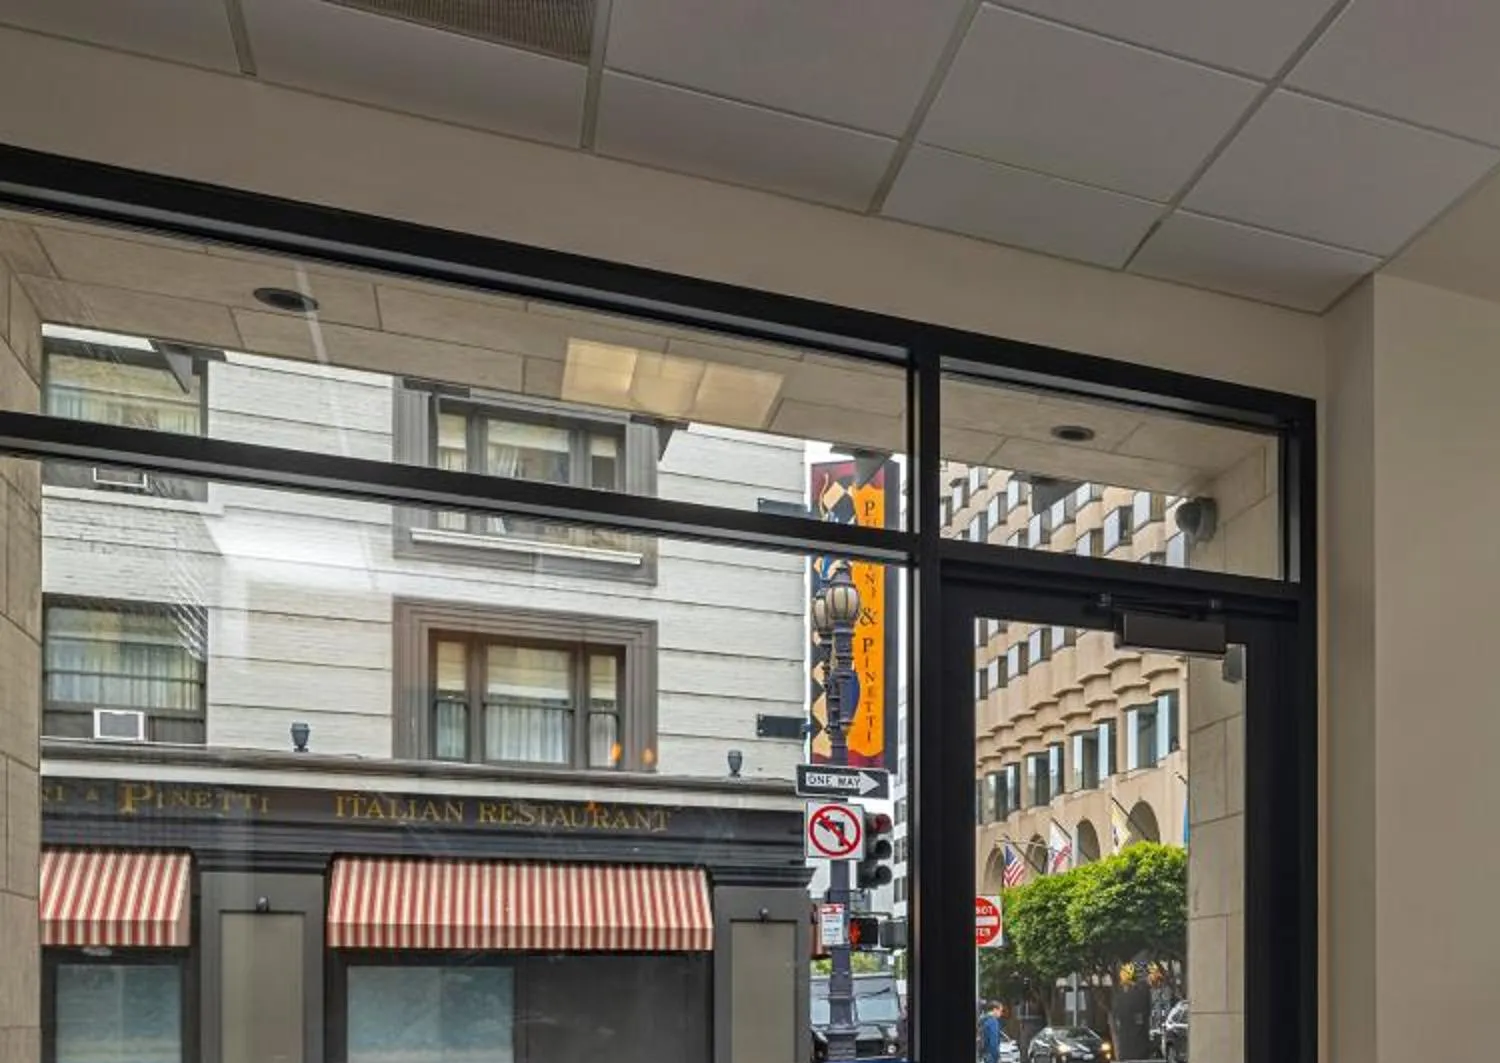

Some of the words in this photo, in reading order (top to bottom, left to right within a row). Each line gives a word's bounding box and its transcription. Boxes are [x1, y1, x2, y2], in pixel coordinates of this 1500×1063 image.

[807, 774, 832, 785] ONE
[838, 775, 860, 787] WAY
[335, 795, 464, 822] ITALIAN
[478, 801, 671, 832] RESTAURANT
